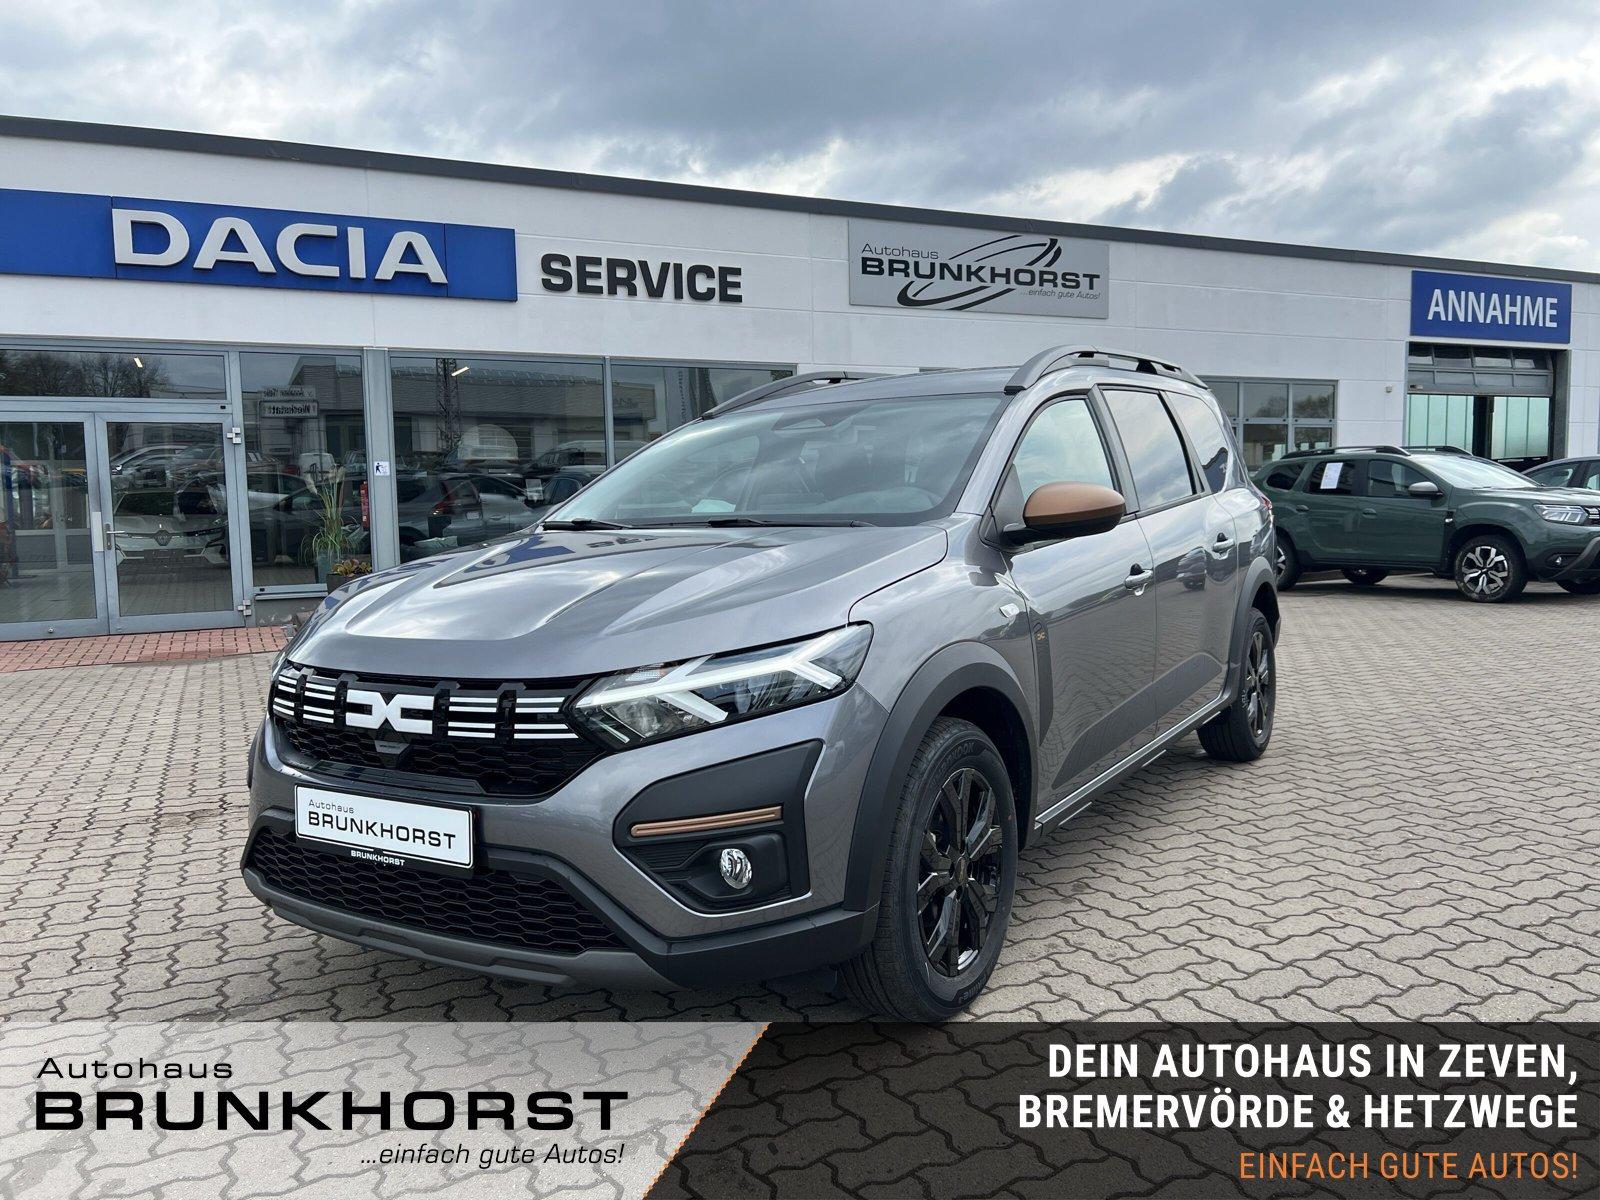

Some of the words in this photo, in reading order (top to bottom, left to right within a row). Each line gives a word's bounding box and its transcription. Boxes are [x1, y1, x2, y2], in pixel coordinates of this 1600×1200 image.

[112, 208, 448, 284] DACIA
[861, 243, 939, 260] Autohaus
[541, 253, 743, 303] SERVICE
[861, 256, 1101, 290] BRUNKHORST
[1057, 291, 1075, 300] gute
[1076, 291, 1101, 300] Autos!
[1427, 288, 1558, 328] ANNAHME
[308, 798, 355, 814] Autohaus
[308, 810, 456, 850] BRUNKHORST
[350, 849, 405, 867] BRUNKHORST
